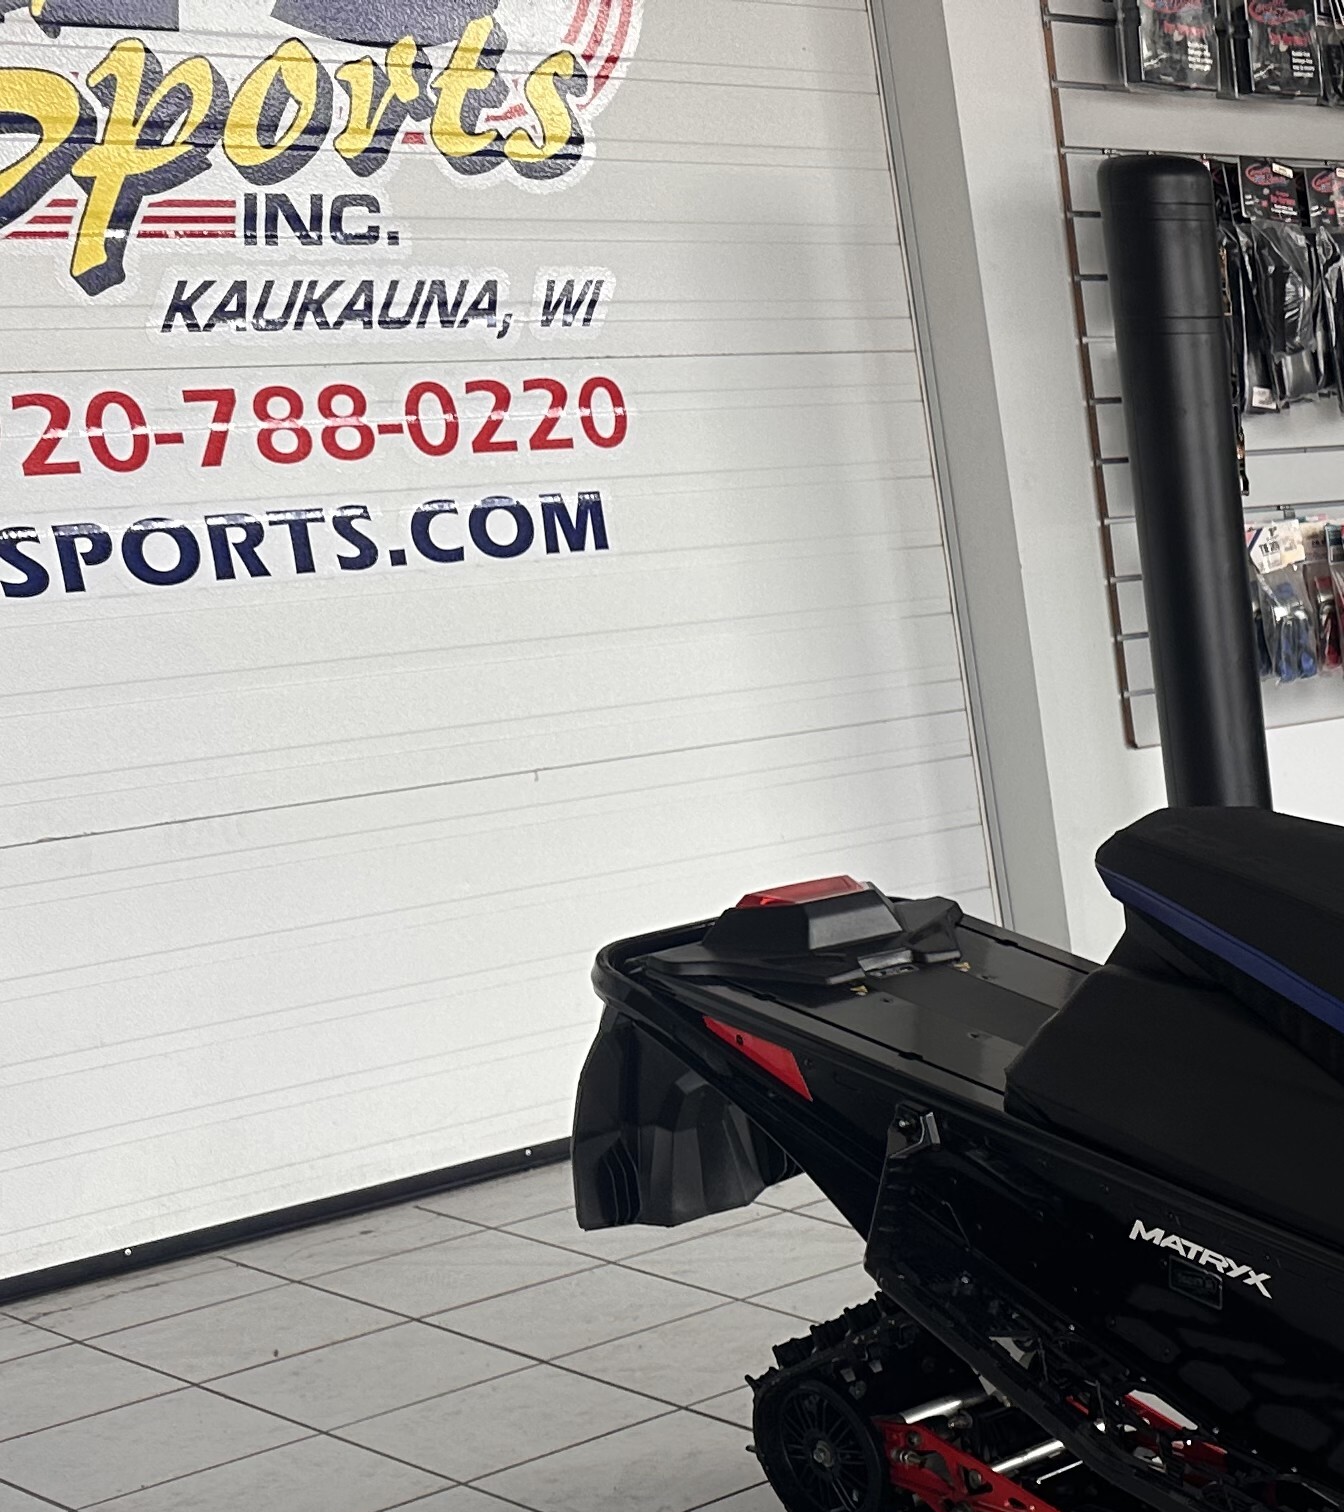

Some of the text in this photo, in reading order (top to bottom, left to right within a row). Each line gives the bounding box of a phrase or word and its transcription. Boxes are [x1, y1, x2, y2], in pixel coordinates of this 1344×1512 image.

[243, 193, 400, 246] INC.
[160, 279, 605, 339] KAUKAUNA, WI
[0, 376, 628, 477] 20-788-0220
[0, 491, 610, 598] SPORTS.COM
[1129, 1219, 1272, 1299] MATRYX
